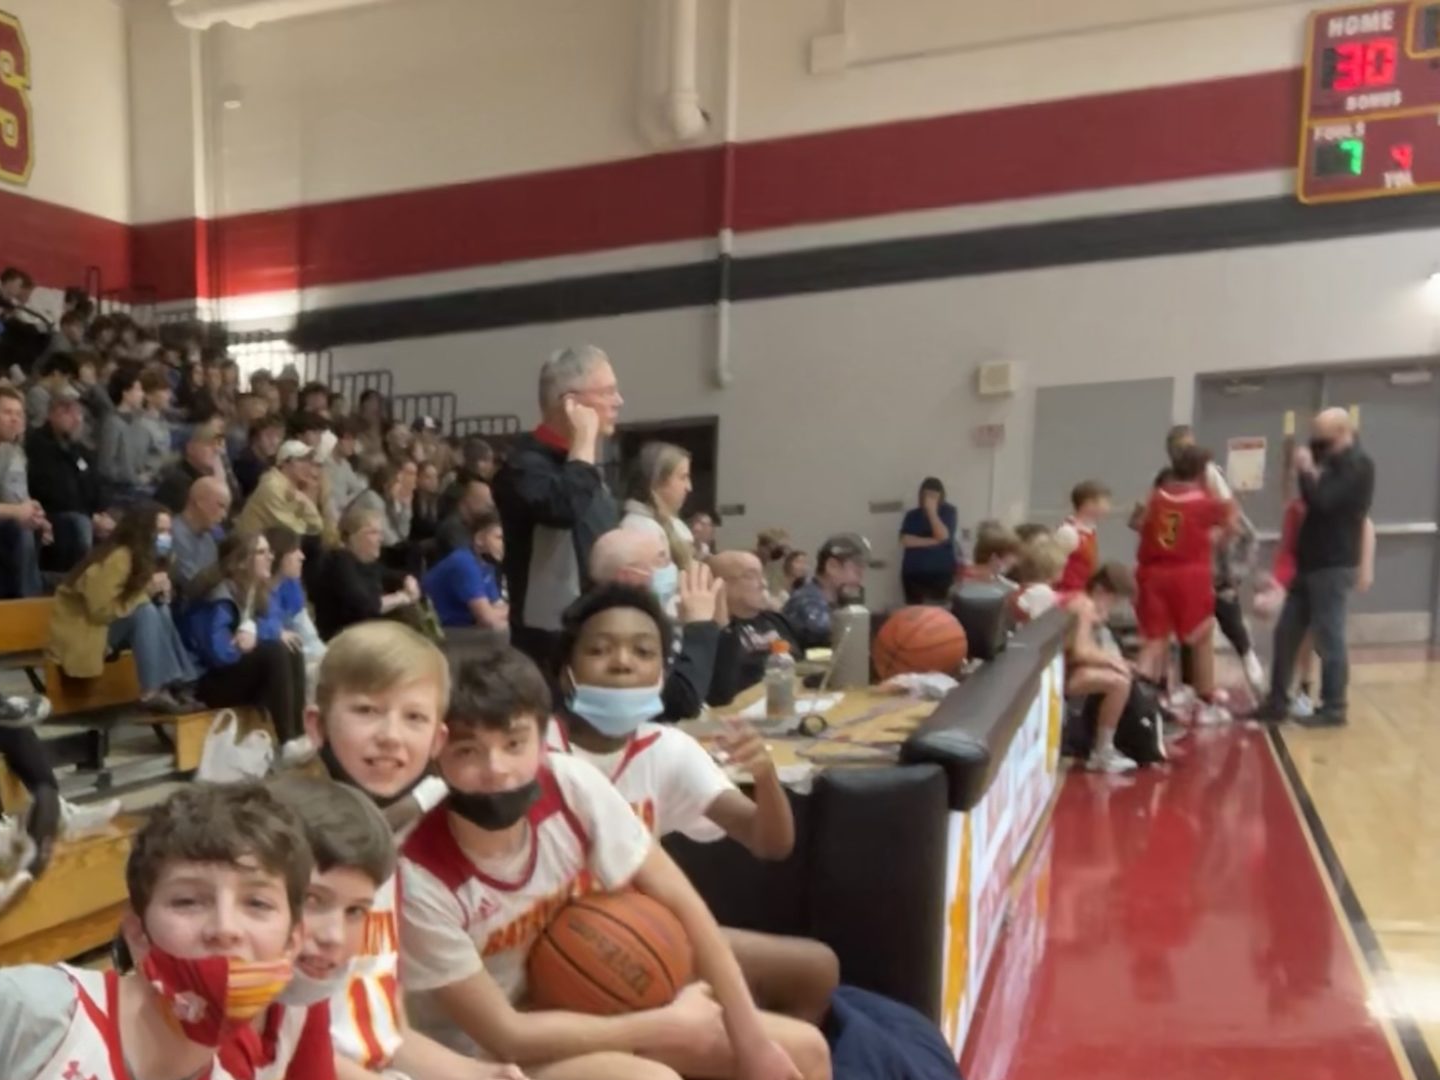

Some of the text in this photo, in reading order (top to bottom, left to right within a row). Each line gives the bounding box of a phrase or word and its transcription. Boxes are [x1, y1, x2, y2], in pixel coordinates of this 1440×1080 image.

[1327, 10, 1395, 39] HOME
[1332, 37, 1398, 92] 30
[1344, 88, 1403, 113] BONUS
[1313, 120, 1366, 142] FOULS
[1338, 138, 1364, 176] 7
